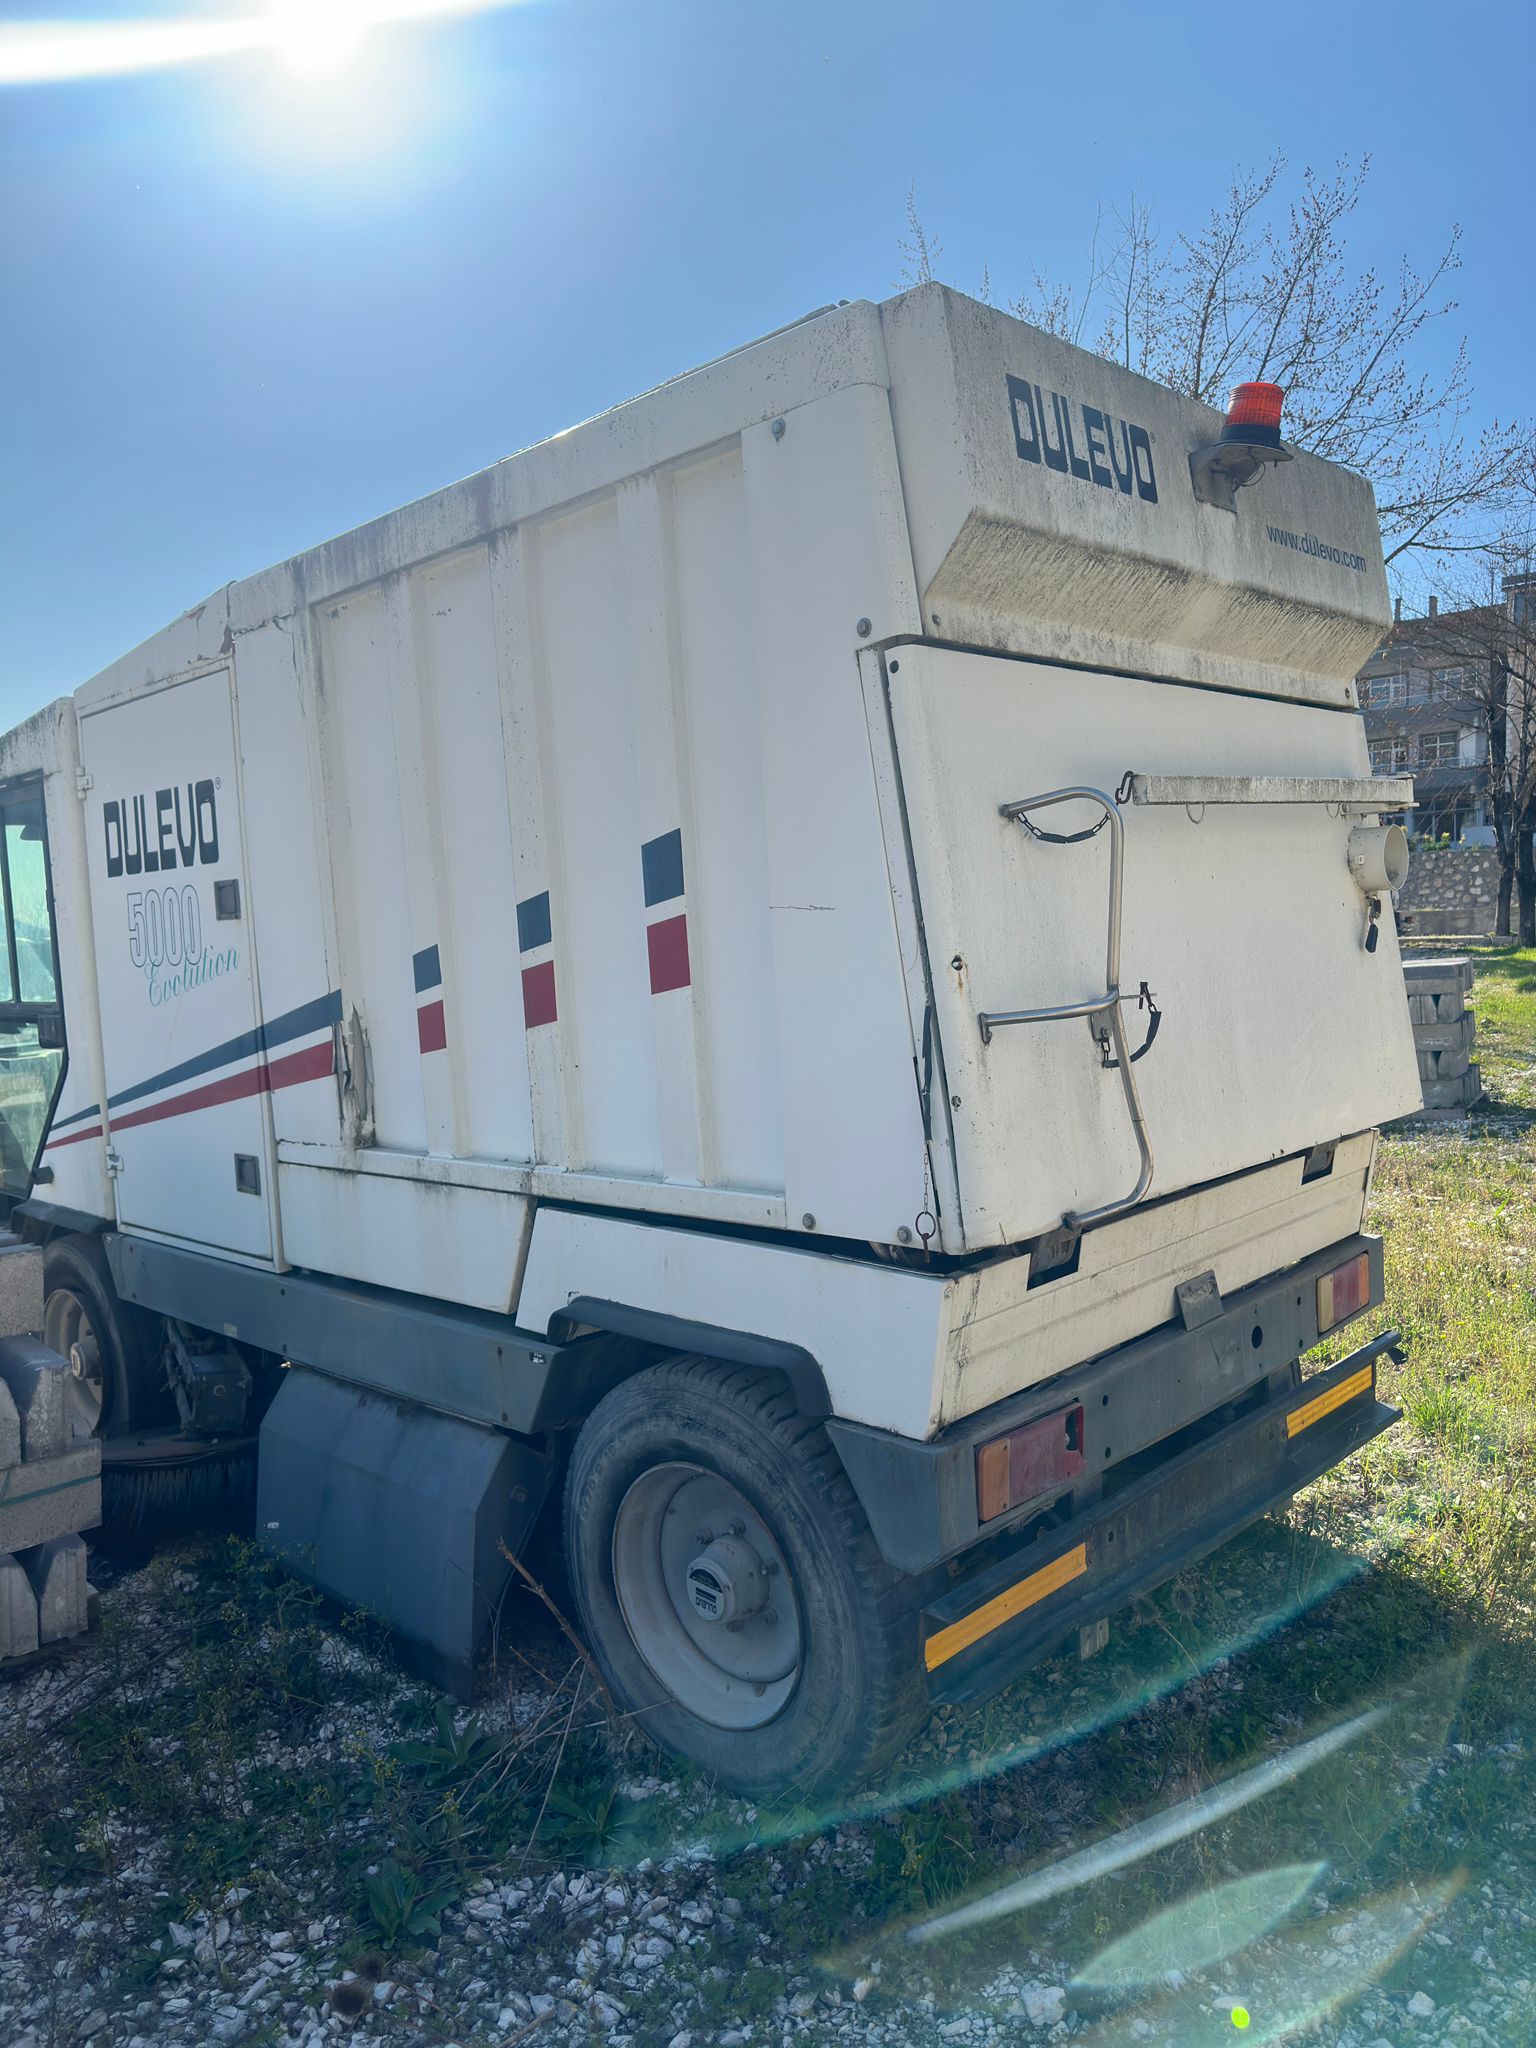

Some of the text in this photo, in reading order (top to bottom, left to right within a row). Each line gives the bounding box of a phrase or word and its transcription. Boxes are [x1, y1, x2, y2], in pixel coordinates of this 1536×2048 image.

[1005, 373, 1158, 504] DULEVO
[1266, 525, 1367, 573] www.dulevo.com
[103, 779, 219, 878] DULEVO
[127, 884, 201, 968] 5000
[145, 945, 240, 1007] Evolution
